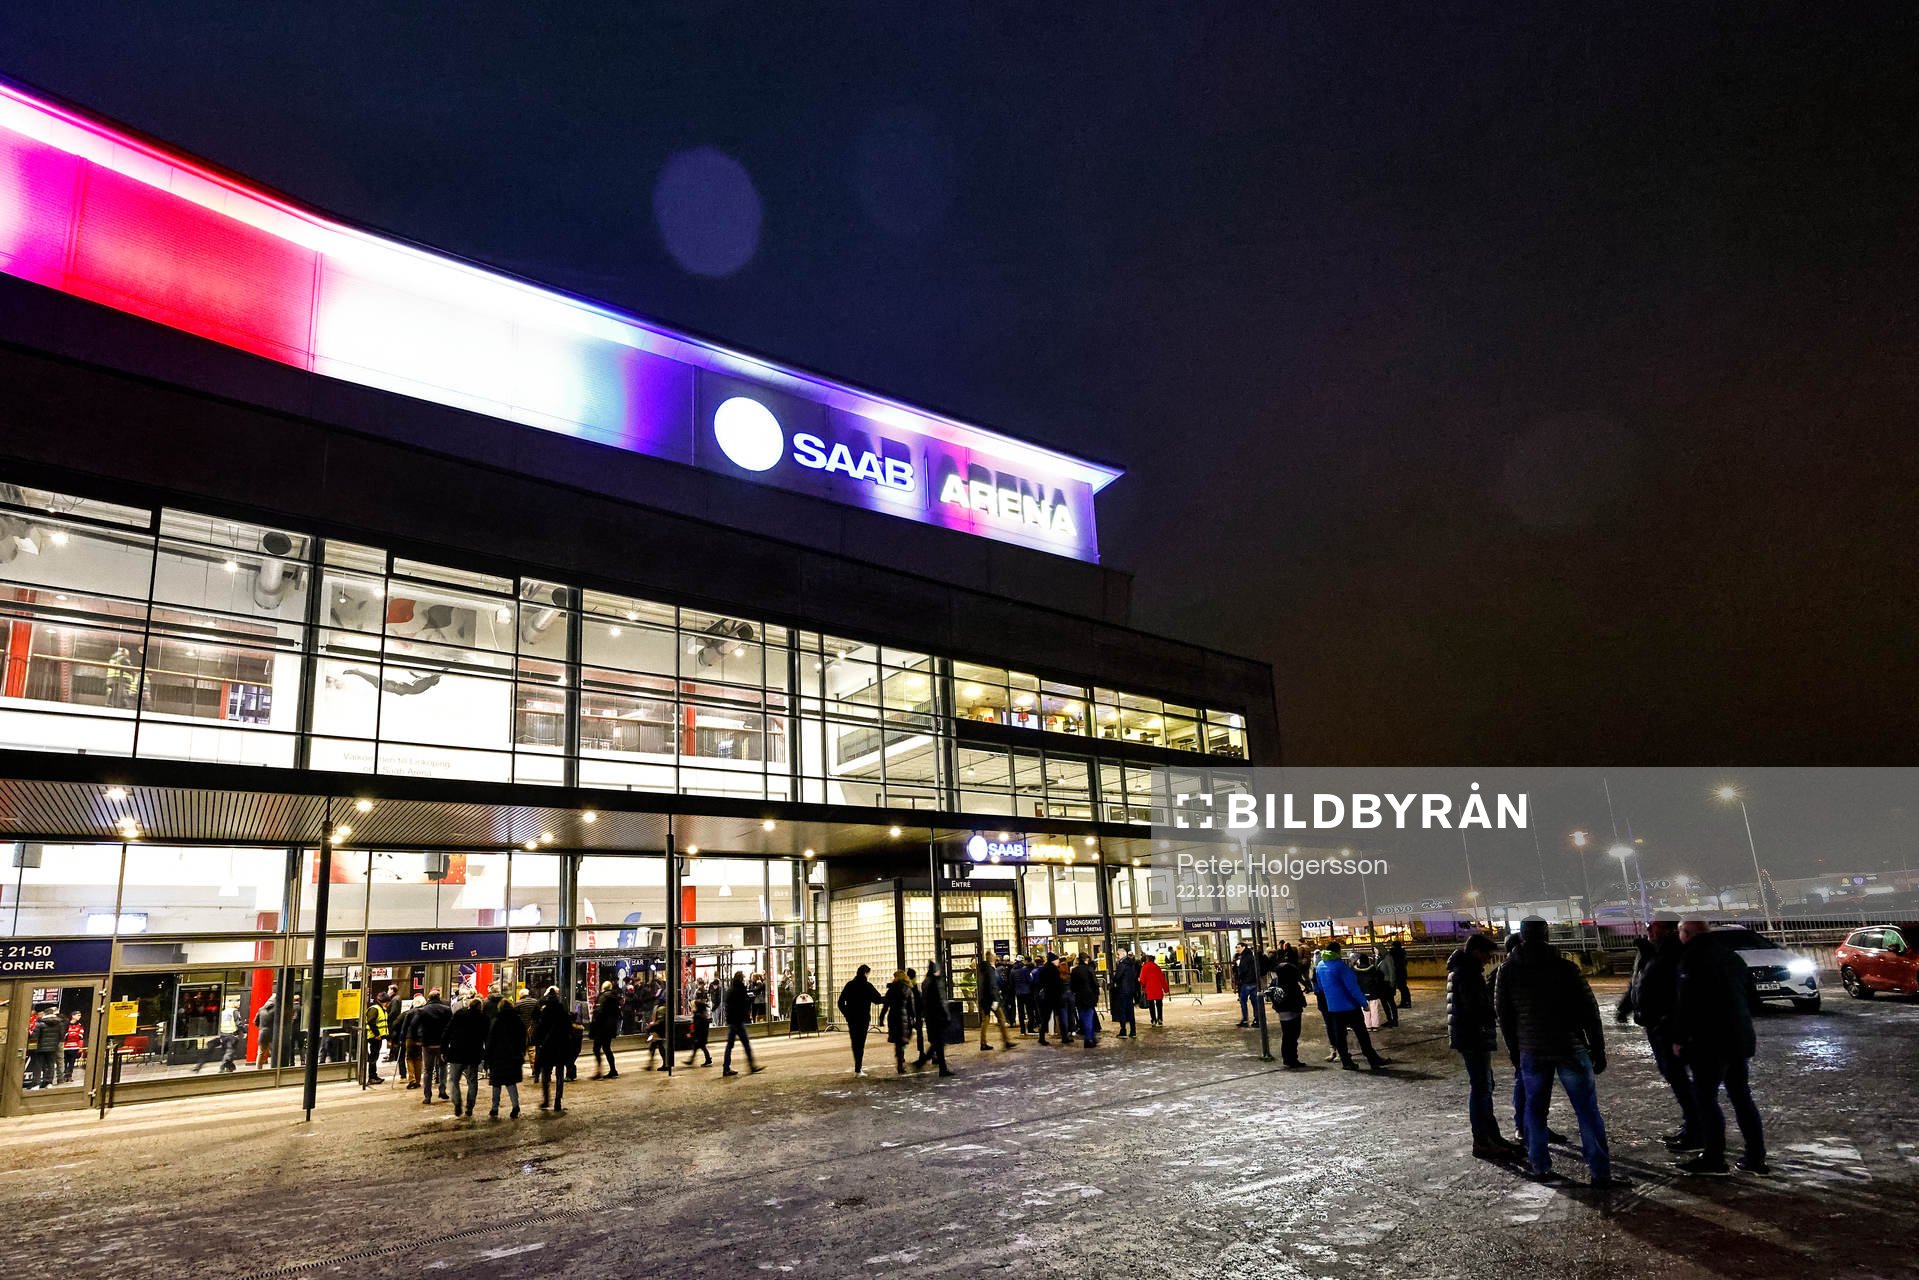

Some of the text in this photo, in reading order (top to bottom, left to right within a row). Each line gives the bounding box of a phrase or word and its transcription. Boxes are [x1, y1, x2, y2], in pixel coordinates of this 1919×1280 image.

[792, 432, 1078, 537] SAAB ARENA
[988, 842, 1025, 857] SAAB
[1377, 904, 1413, 914] VOLVO
[1301, 920, 1334, 929] VOLVO
[8, 946, 52, 958] 21-50
[0, 960, 55, 971] ORNER
